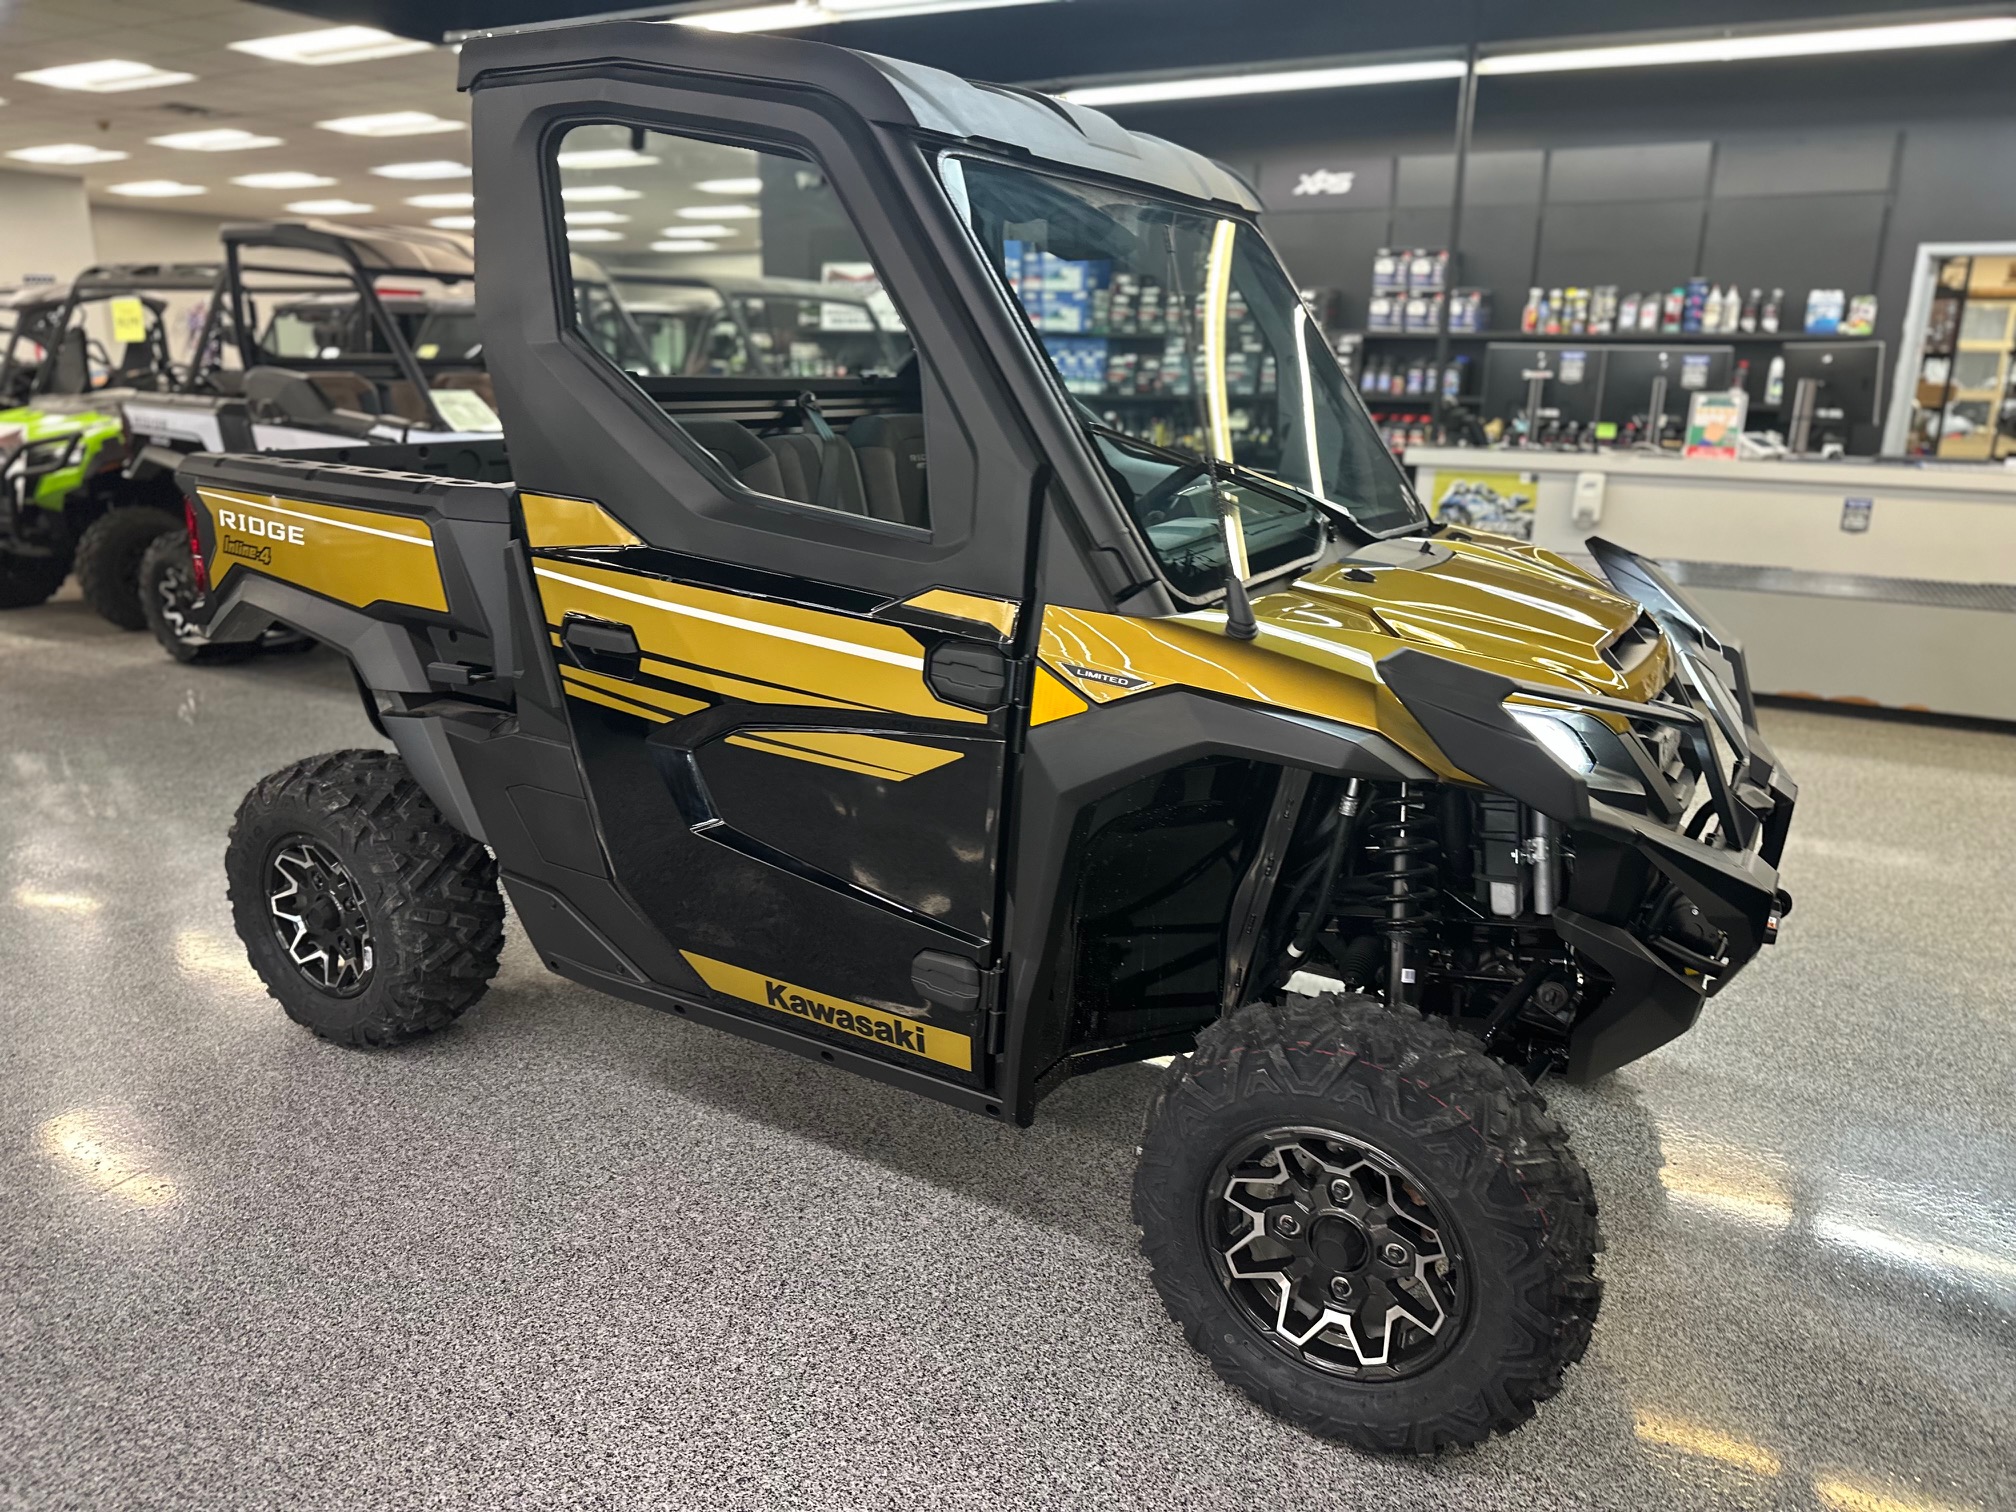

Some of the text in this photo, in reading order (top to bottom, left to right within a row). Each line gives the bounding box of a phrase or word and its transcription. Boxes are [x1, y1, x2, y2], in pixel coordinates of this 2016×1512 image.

[218, 508, 305, 546] RIDGE
[223, 534, 272, 565] Inline-4
[1076, 668, 1129, 686] LIMITED
[765, 980, 926, 1054] Kawasaki
